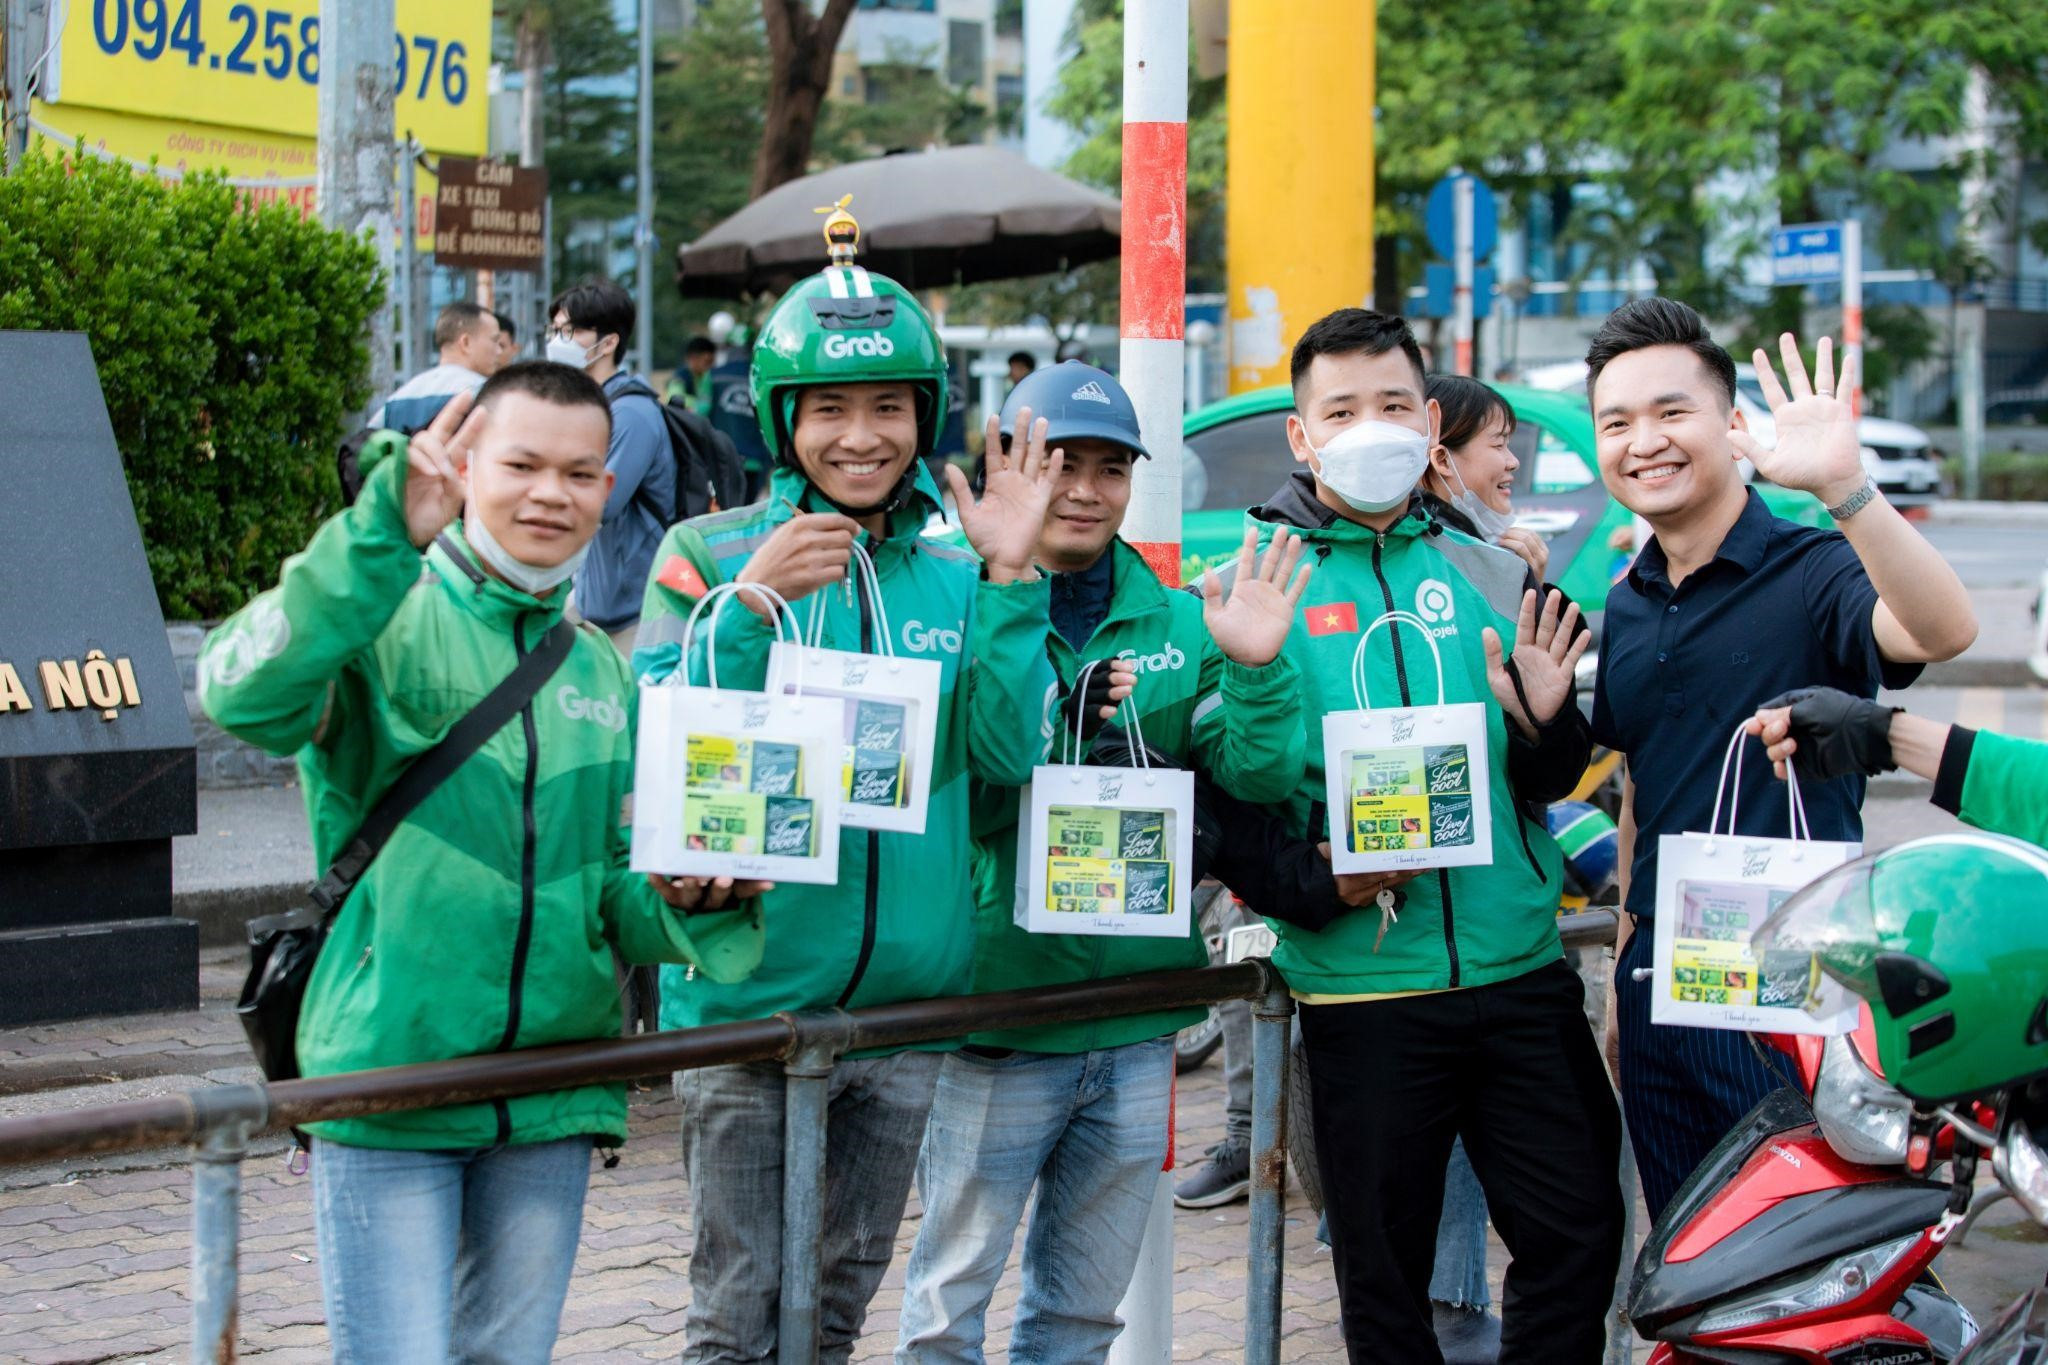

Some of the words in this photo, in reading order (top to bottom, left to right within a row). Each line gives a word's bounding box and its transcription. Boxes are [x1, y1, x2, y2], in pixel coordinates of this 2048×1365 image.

[440, 186, 460, 208] XE
[464, 187, 500, 208] TAXI
[824, 330, 894, 359] Grab
[1426, 623, 1459, 641] ojek
[38, 649, 142, 722] NỘI
[1431, 765, 1460, 785] Live
[1434, 814, 1463, 835] Live
